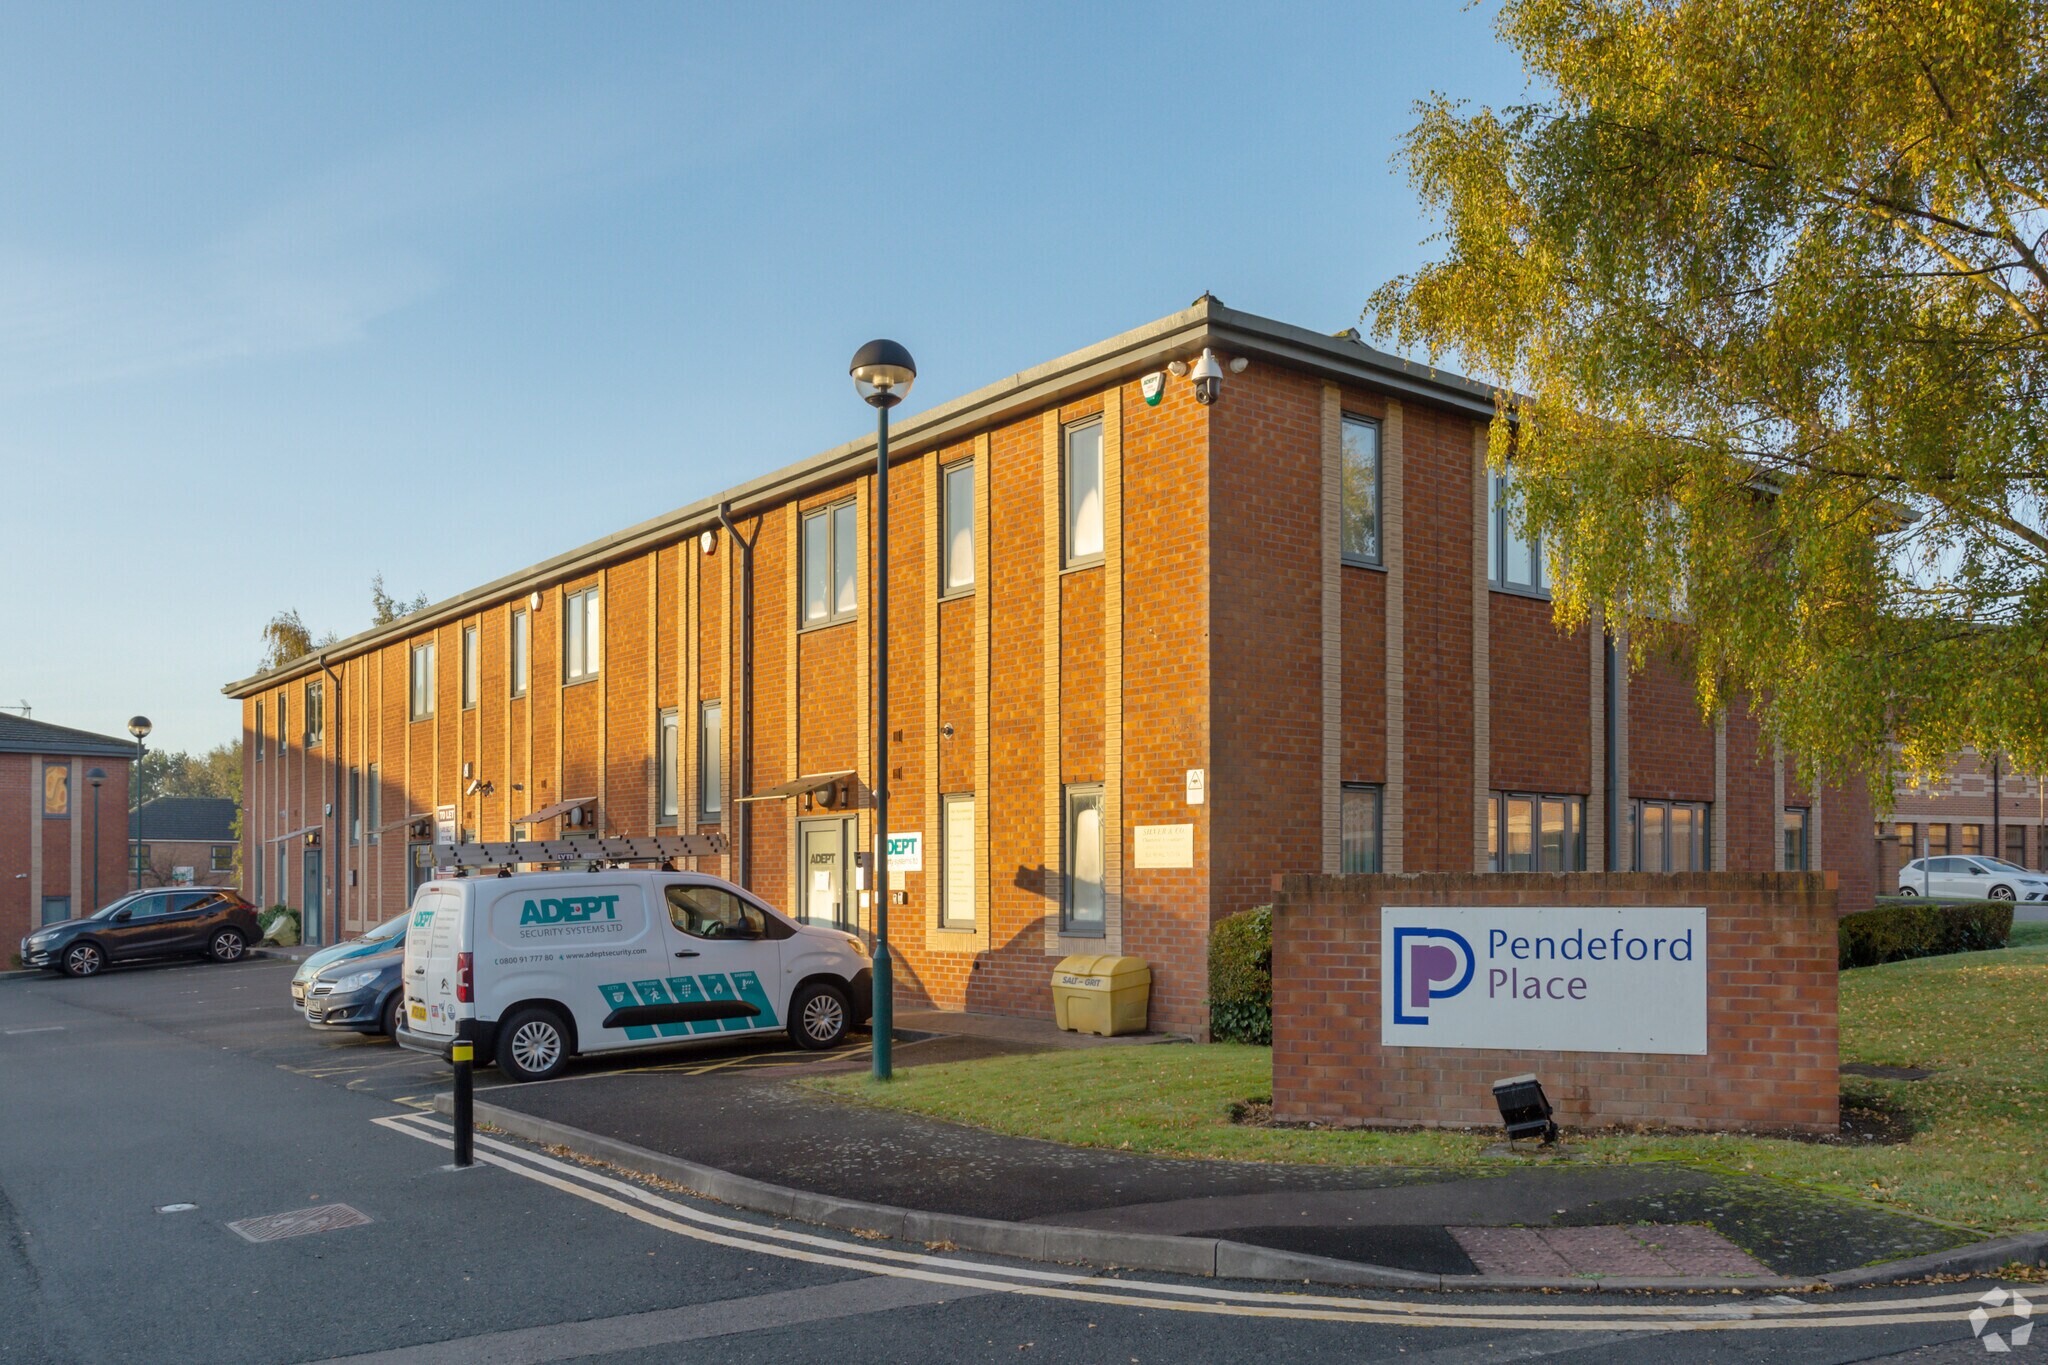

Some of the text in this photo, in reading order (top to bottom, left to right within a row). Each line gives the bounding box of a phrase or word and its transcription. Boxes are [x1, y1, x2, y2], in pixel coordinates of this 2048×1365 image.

[439, 810, 454, 820] TO LET
[887, 838, 917, 855] DEPT
[810, 853, 836, 864] ADEPT
[520, 895, 619, 925] ADEPT
[414, 911, 435, 927] ADEPT
[520, 924, 623, 939] SECURITY SYSTEMS LTD
[1489, 928, 1693, 961] Pendeford
[499, 957, 518, 965] 0800
[566, 949, 647, 960] www.adeptsecurity.com
[1062, 976, 1078, 985] SALT
[1085, 979, 1101, 987] GRIT
[1489, 967, 1588, 1000] Place
